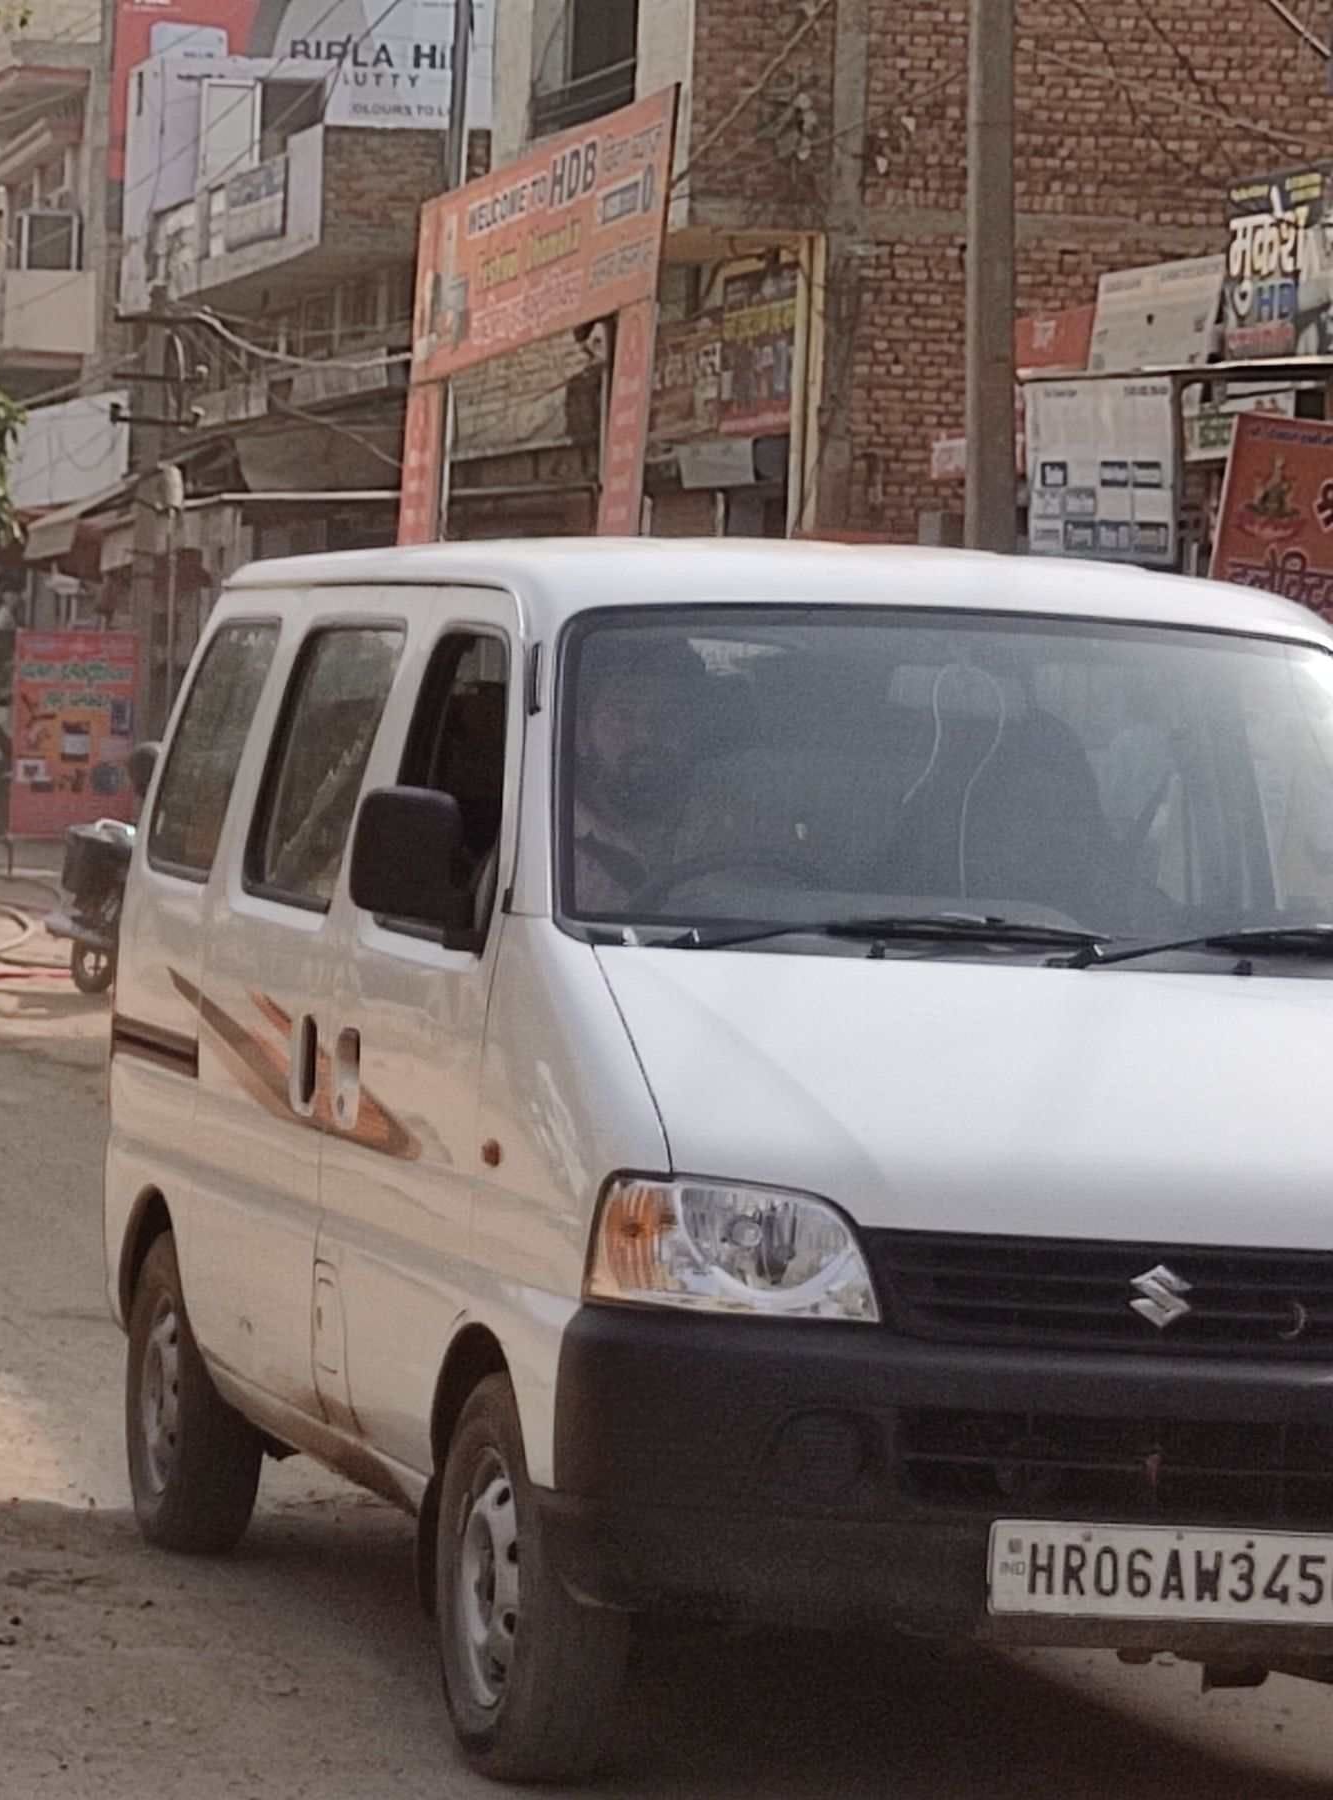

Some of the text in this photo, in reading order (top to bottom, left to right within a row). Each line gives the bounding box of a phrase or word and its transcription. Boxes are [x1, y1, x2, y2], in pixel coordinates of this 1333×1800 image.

[290, 39, 454, 69] BIRLA Hi
[342, 71, 420, 88] UTTY
[351, 103, 412, 116] OLOURS
[468, 183, 527, 234] WELCOME
[531, 174, 548, 205] TO
[548, 139, 597, 208] HDB
[1028, 1542, 1333, 1605] HR06AW345
